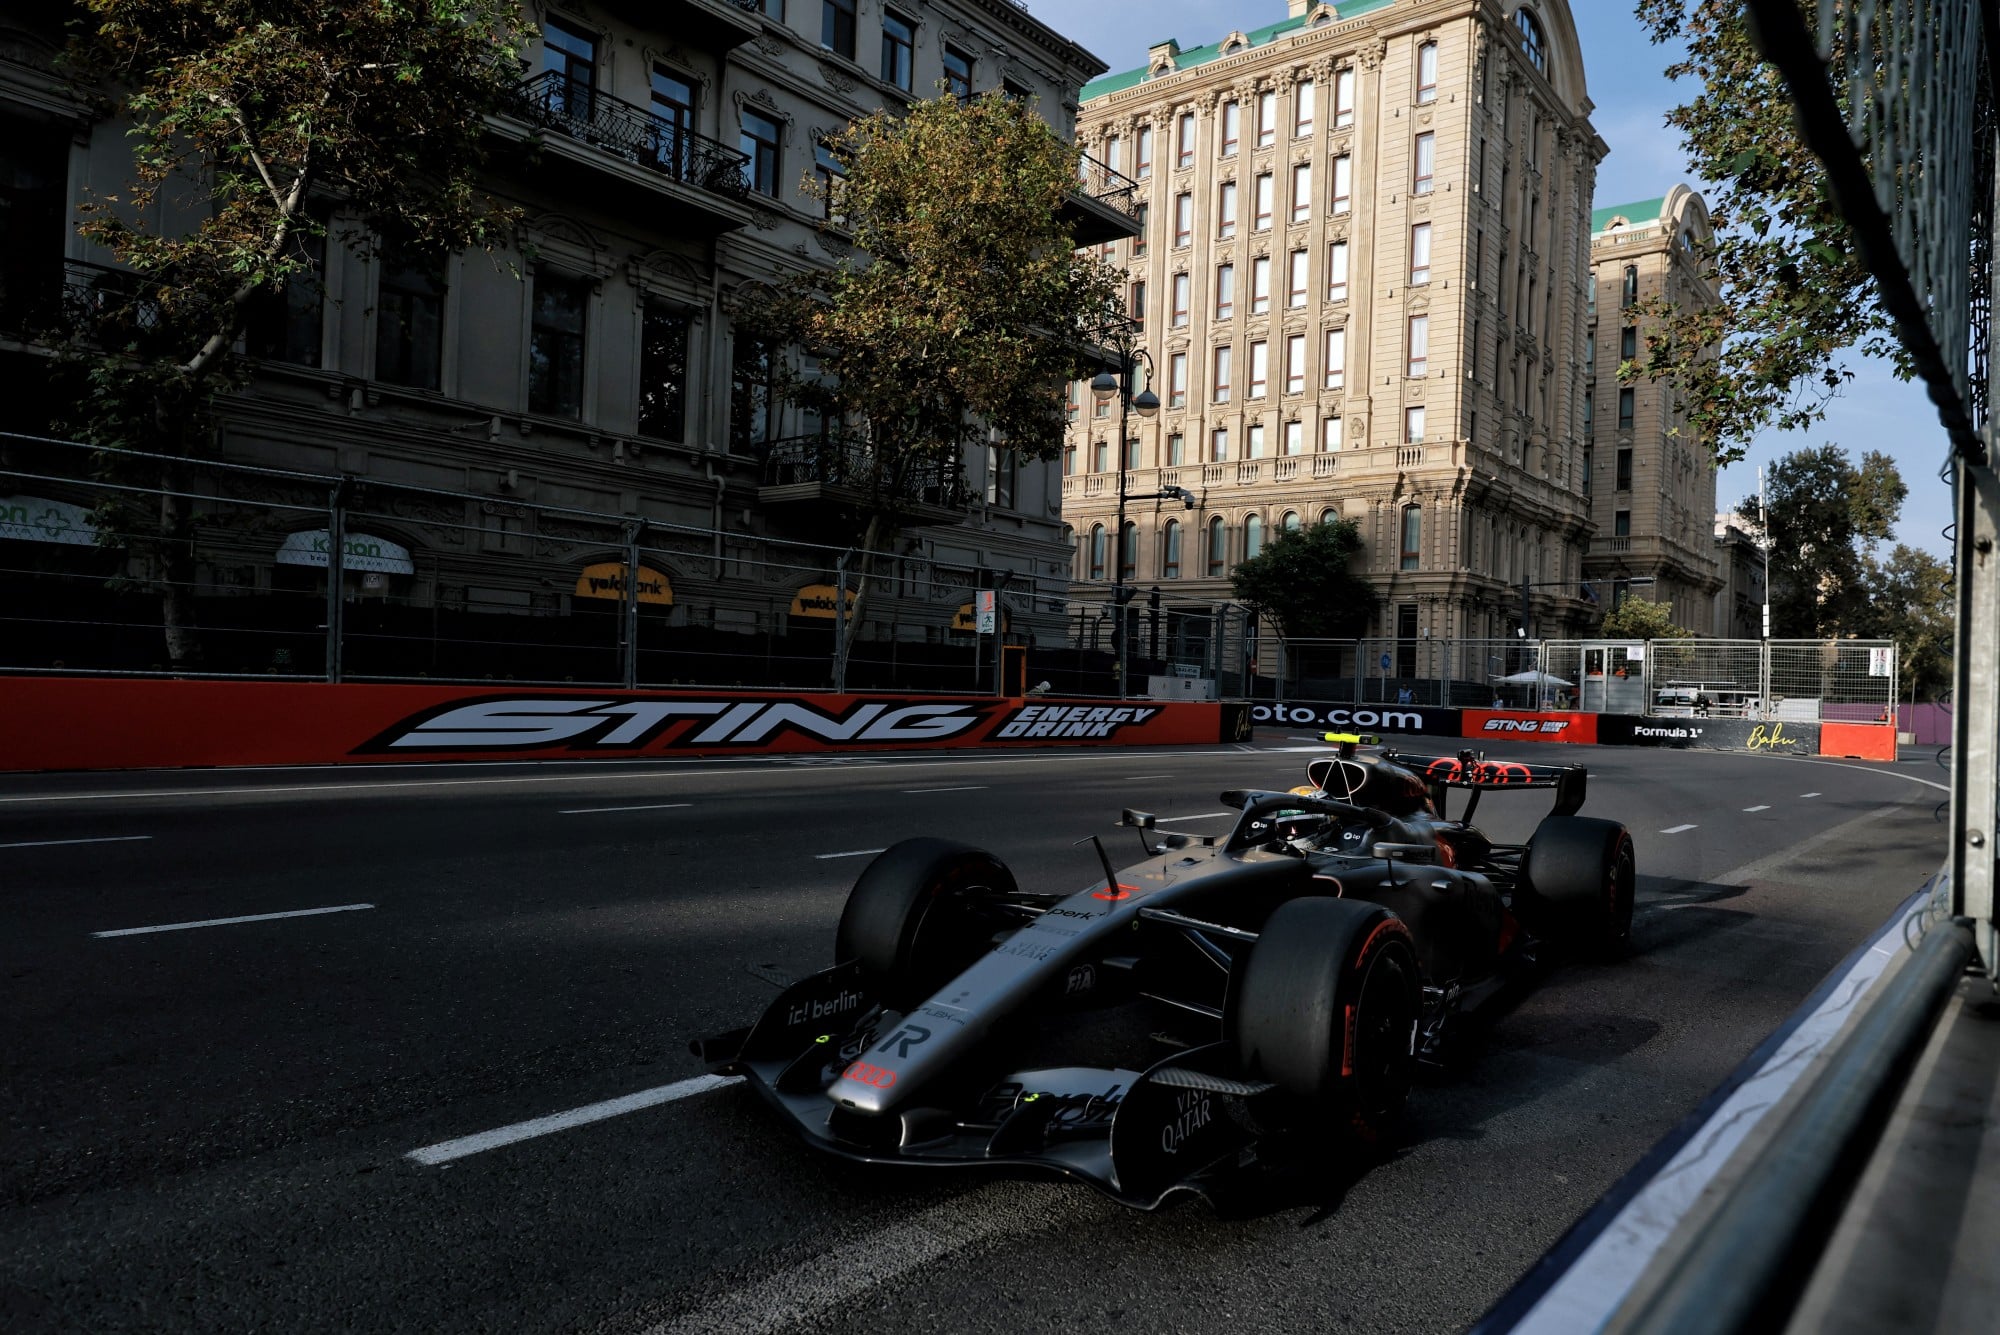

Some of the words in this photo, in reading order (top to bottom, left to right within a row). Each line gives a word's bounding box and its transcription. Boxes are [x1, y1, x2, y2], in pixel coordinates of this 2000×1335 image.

[313, 538, 381, 557] Knon
[1013, 706, 1156, 722] ENERGY
[389, 701, 980, 747] STING
[996, 722, 1117, 737] DRINK
[1484, 720, 1538, 732] STING
[1635, 726, 1688, 738] Formula
[1747, 722, 1797, 750] Baku
[1161, 1098, 1212, 1154] QATAR
